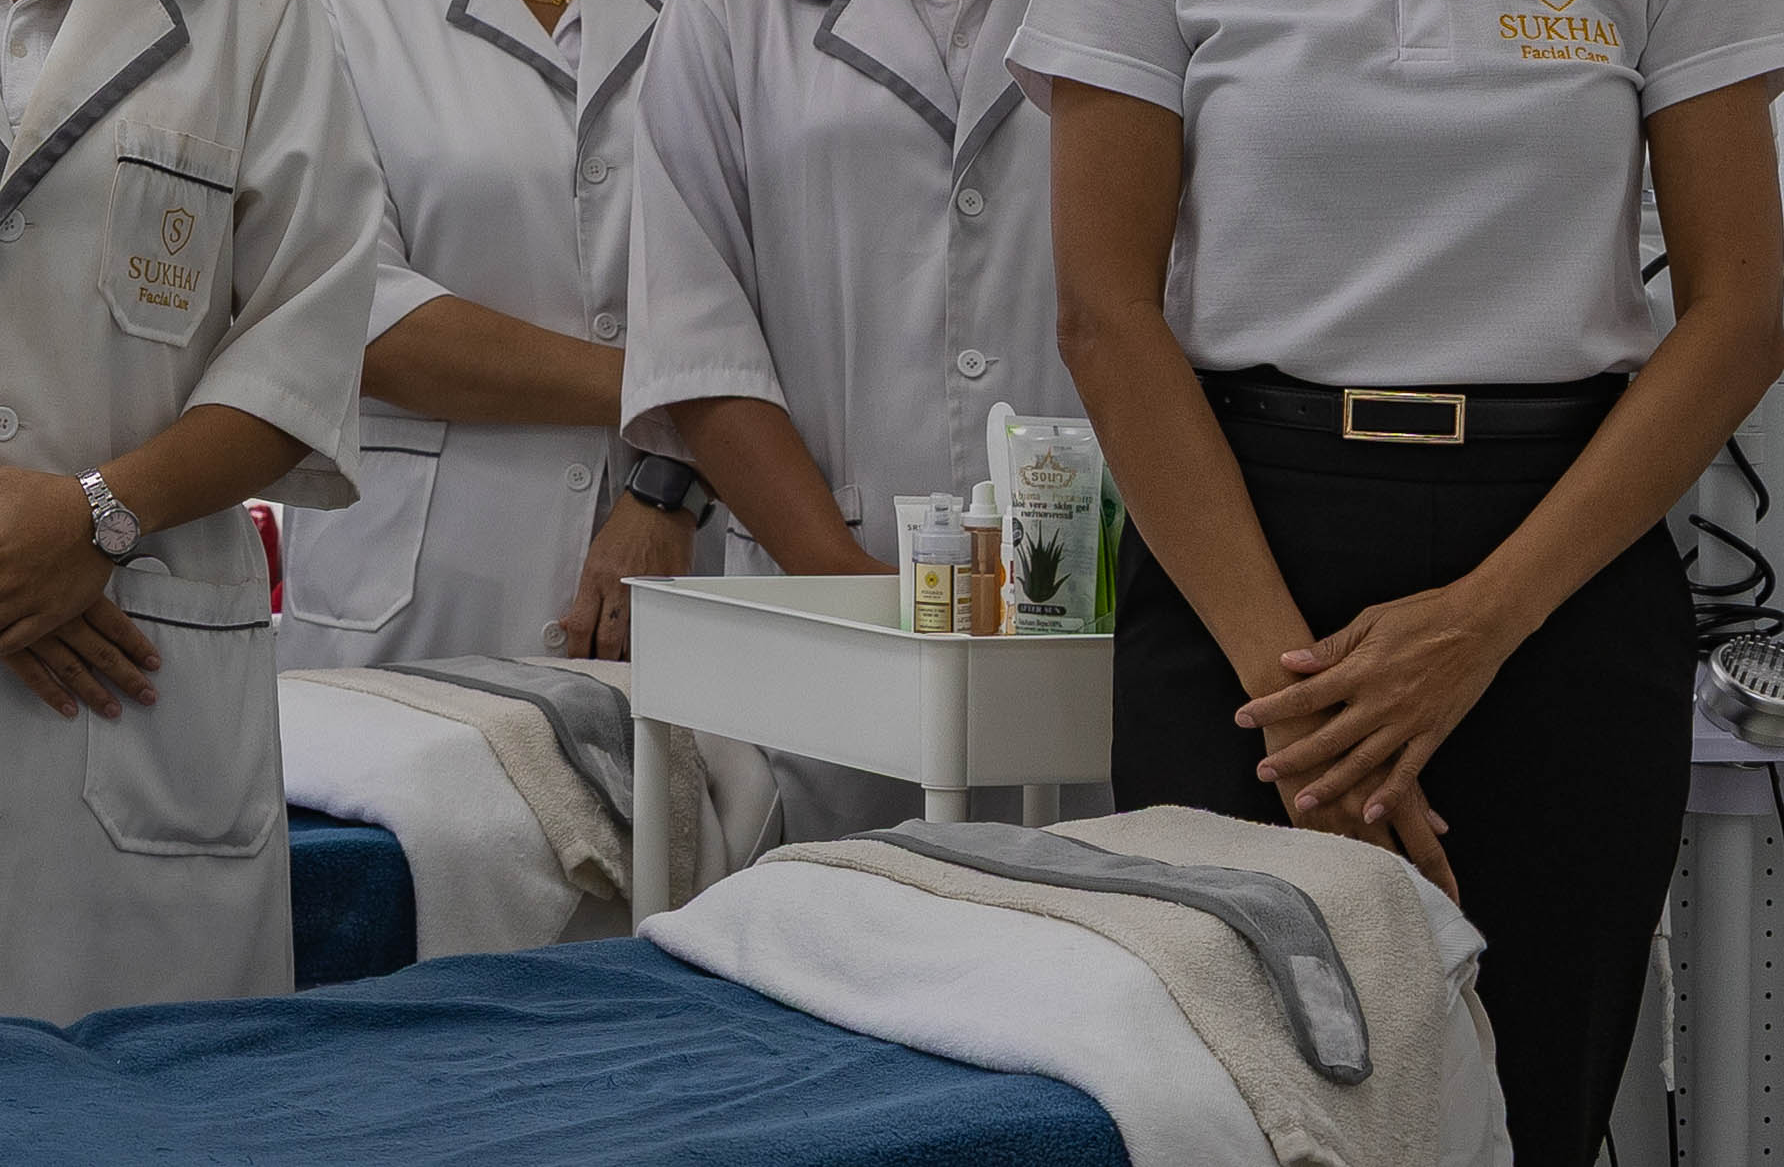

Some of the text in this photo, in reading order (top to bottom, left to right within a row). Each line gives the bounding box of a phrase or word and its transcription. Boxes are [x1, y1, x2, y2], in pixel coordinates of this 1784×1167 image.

[1499, 13, 1619, 47] SUKHAI
[1521, 45, 1610, 64] Facial Care
[169, 218, 184, 243] S
[128, 256, 201, 292] SUKHAI
